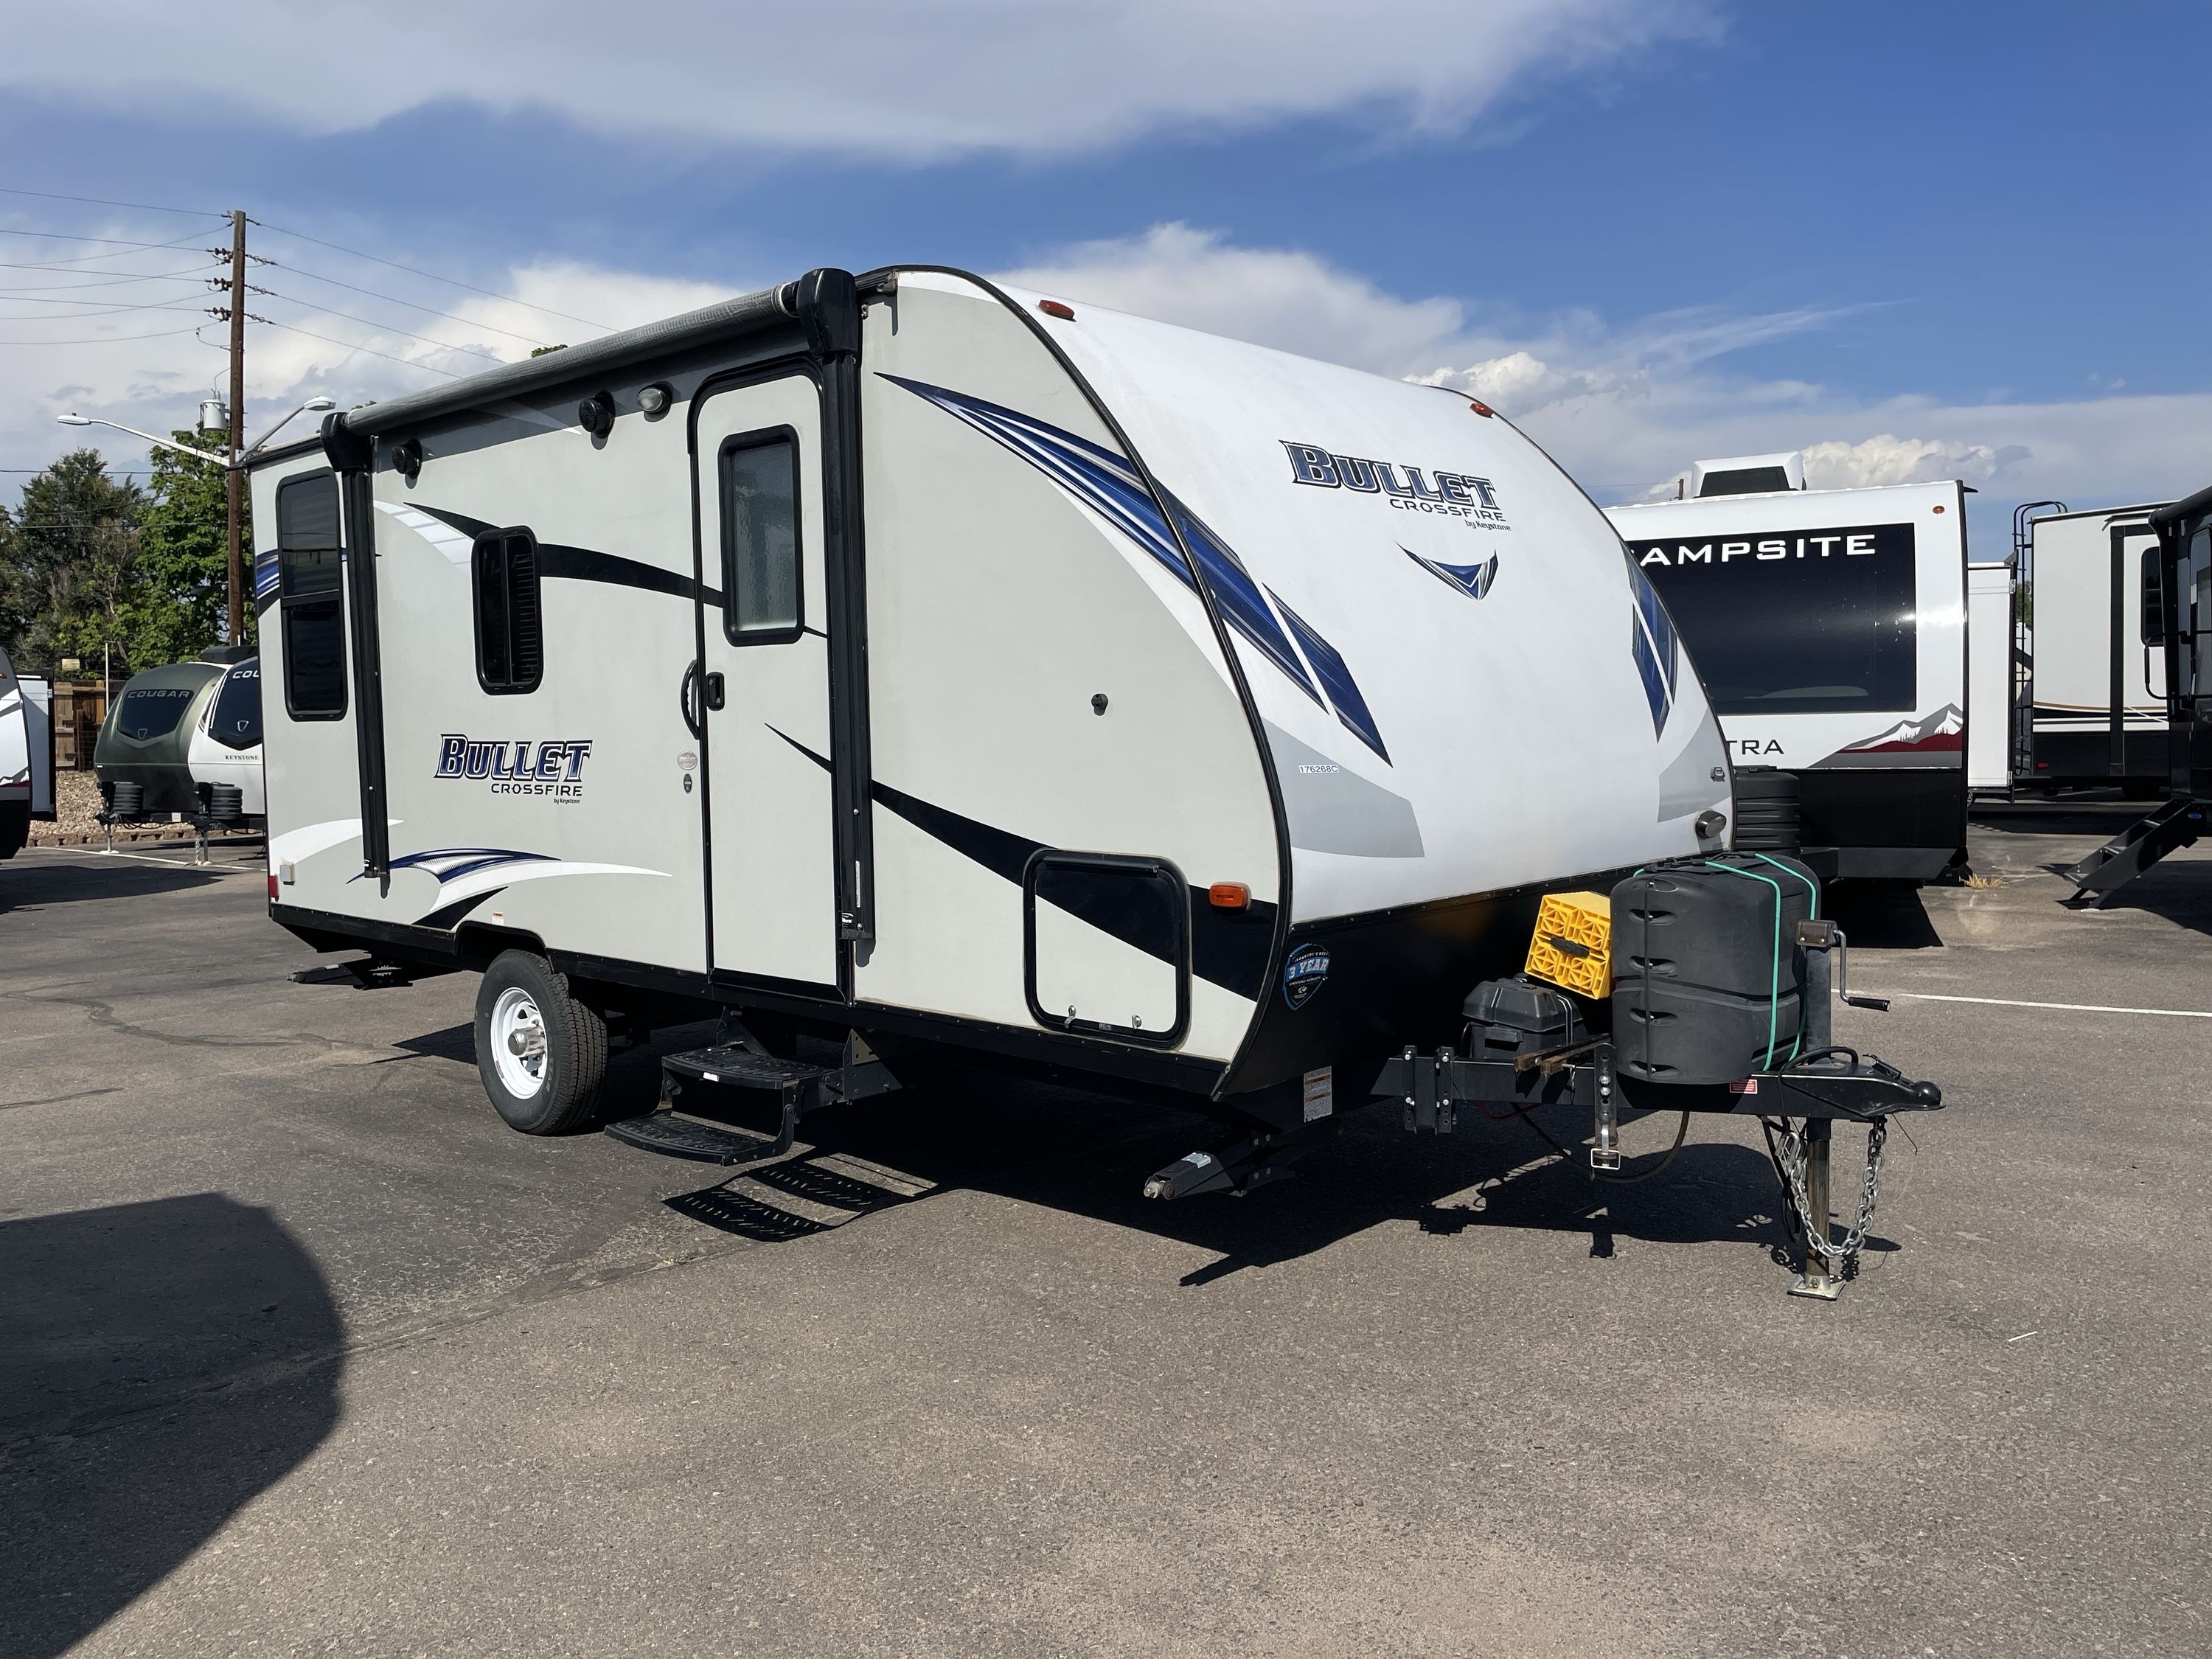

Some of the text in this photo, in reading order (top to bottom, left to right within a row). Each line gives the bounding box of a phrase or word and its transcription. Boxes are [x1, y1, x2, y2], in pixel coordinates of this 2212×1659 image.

[1278, 439, 1501, 510] BULLET
[1390, 498, 1506, 522] CROSSFIRE
[1464, 519, 1512, 532] by Keystone
[1630, 534, 1876, 567] AMPSITE
[128, 690, 189, 698] COUGAR
[434, 733, 593, 782] BULLET
[491, 783, 583, 796] CROSSFIRE
[1288, 959, 1329, 979] 3 YEAR
